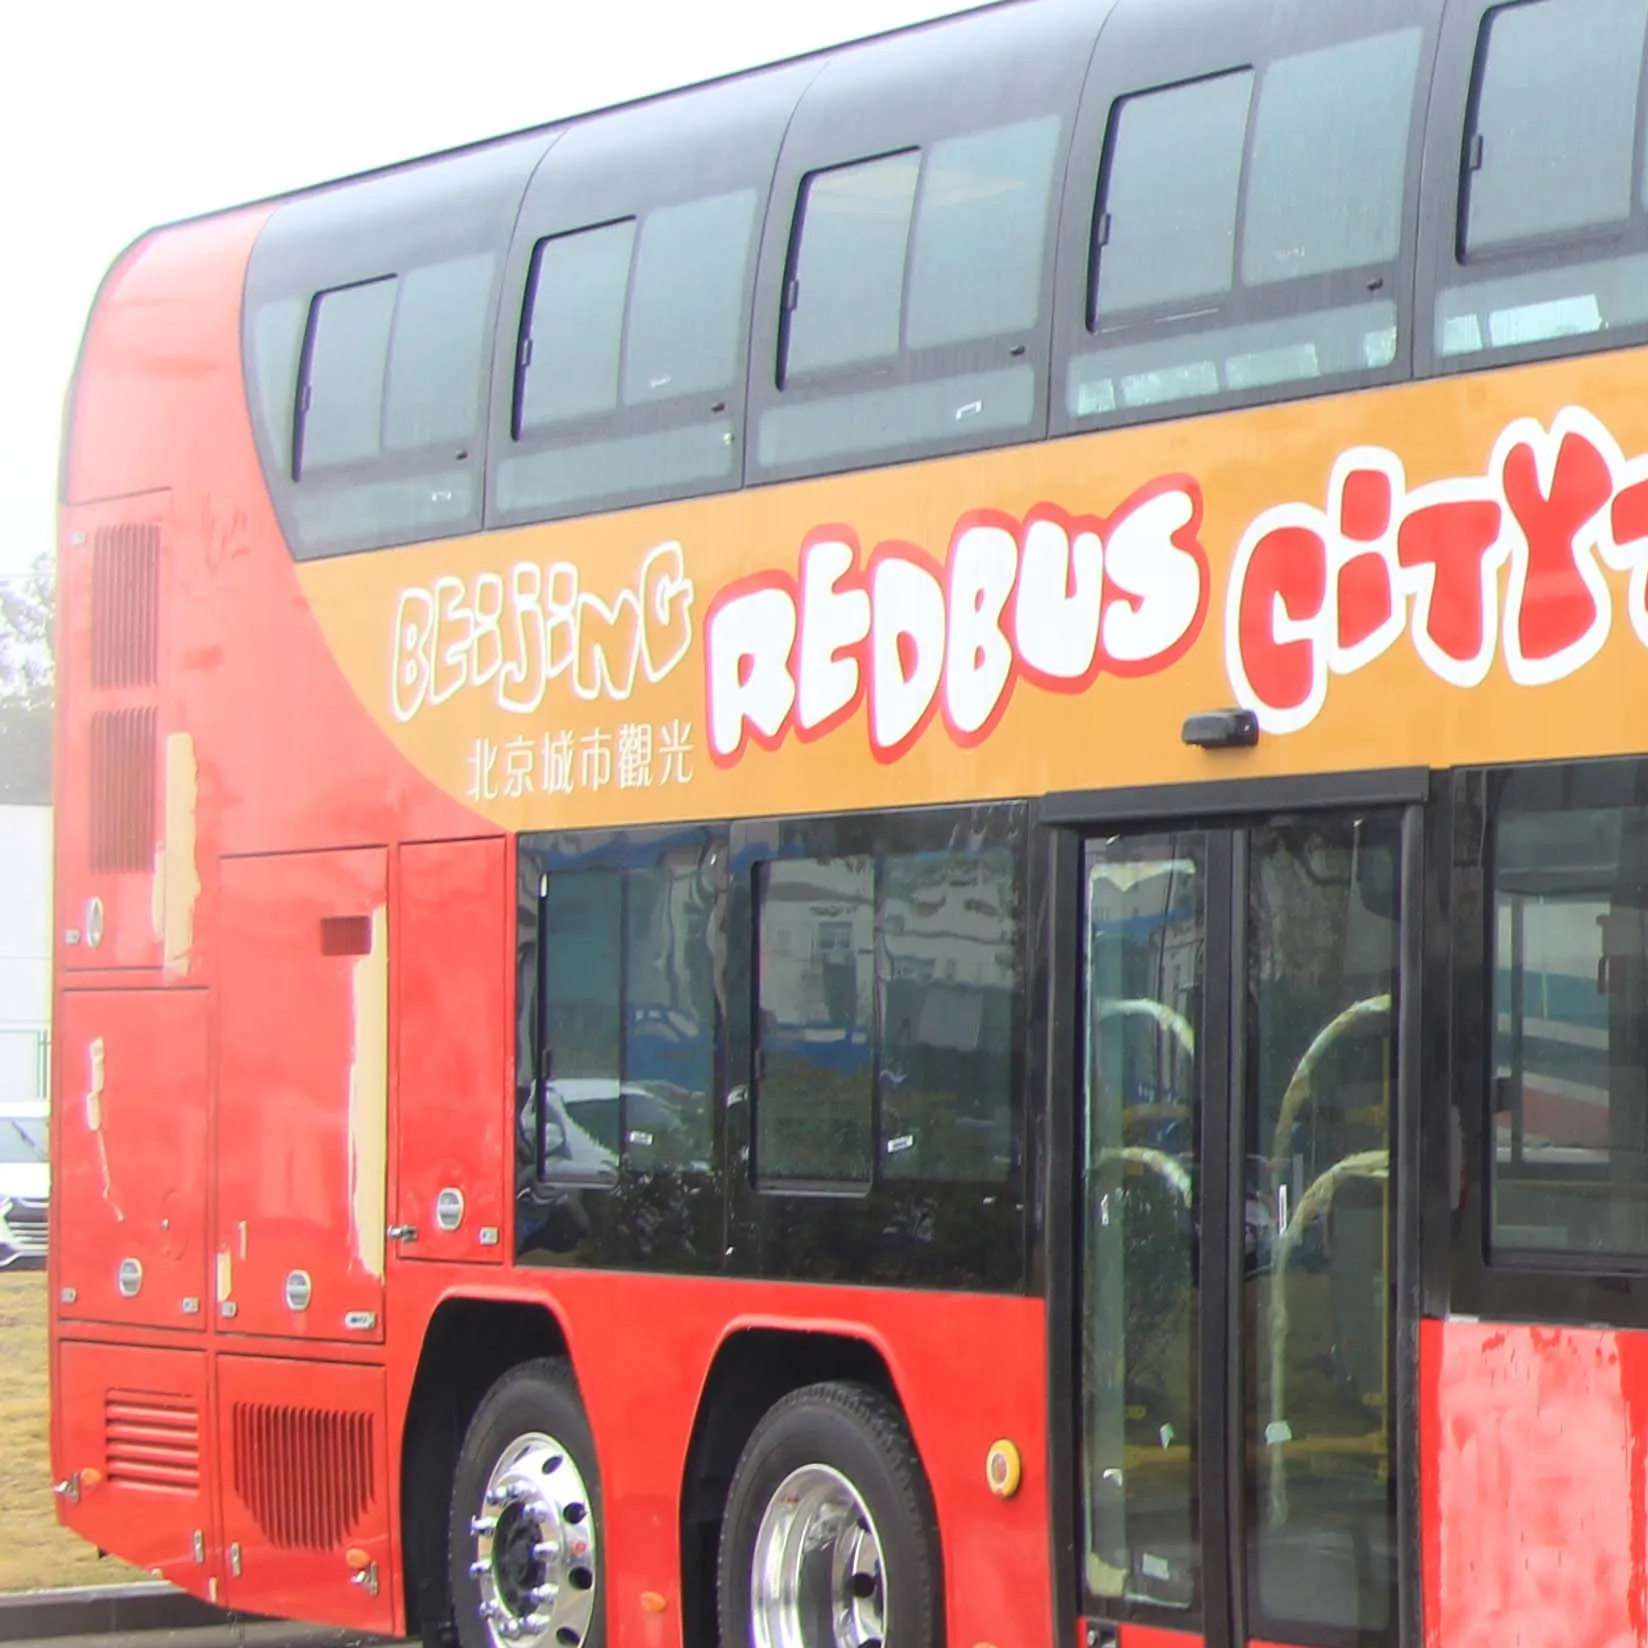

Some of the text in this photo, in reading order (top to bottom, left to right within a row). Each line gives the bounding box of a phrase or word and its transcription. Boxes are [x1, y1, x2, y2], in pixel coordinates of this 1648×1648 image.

[705, 473, 1209, 768] REDBUS
[466, 718, 695, 801] 北京城市觀光
